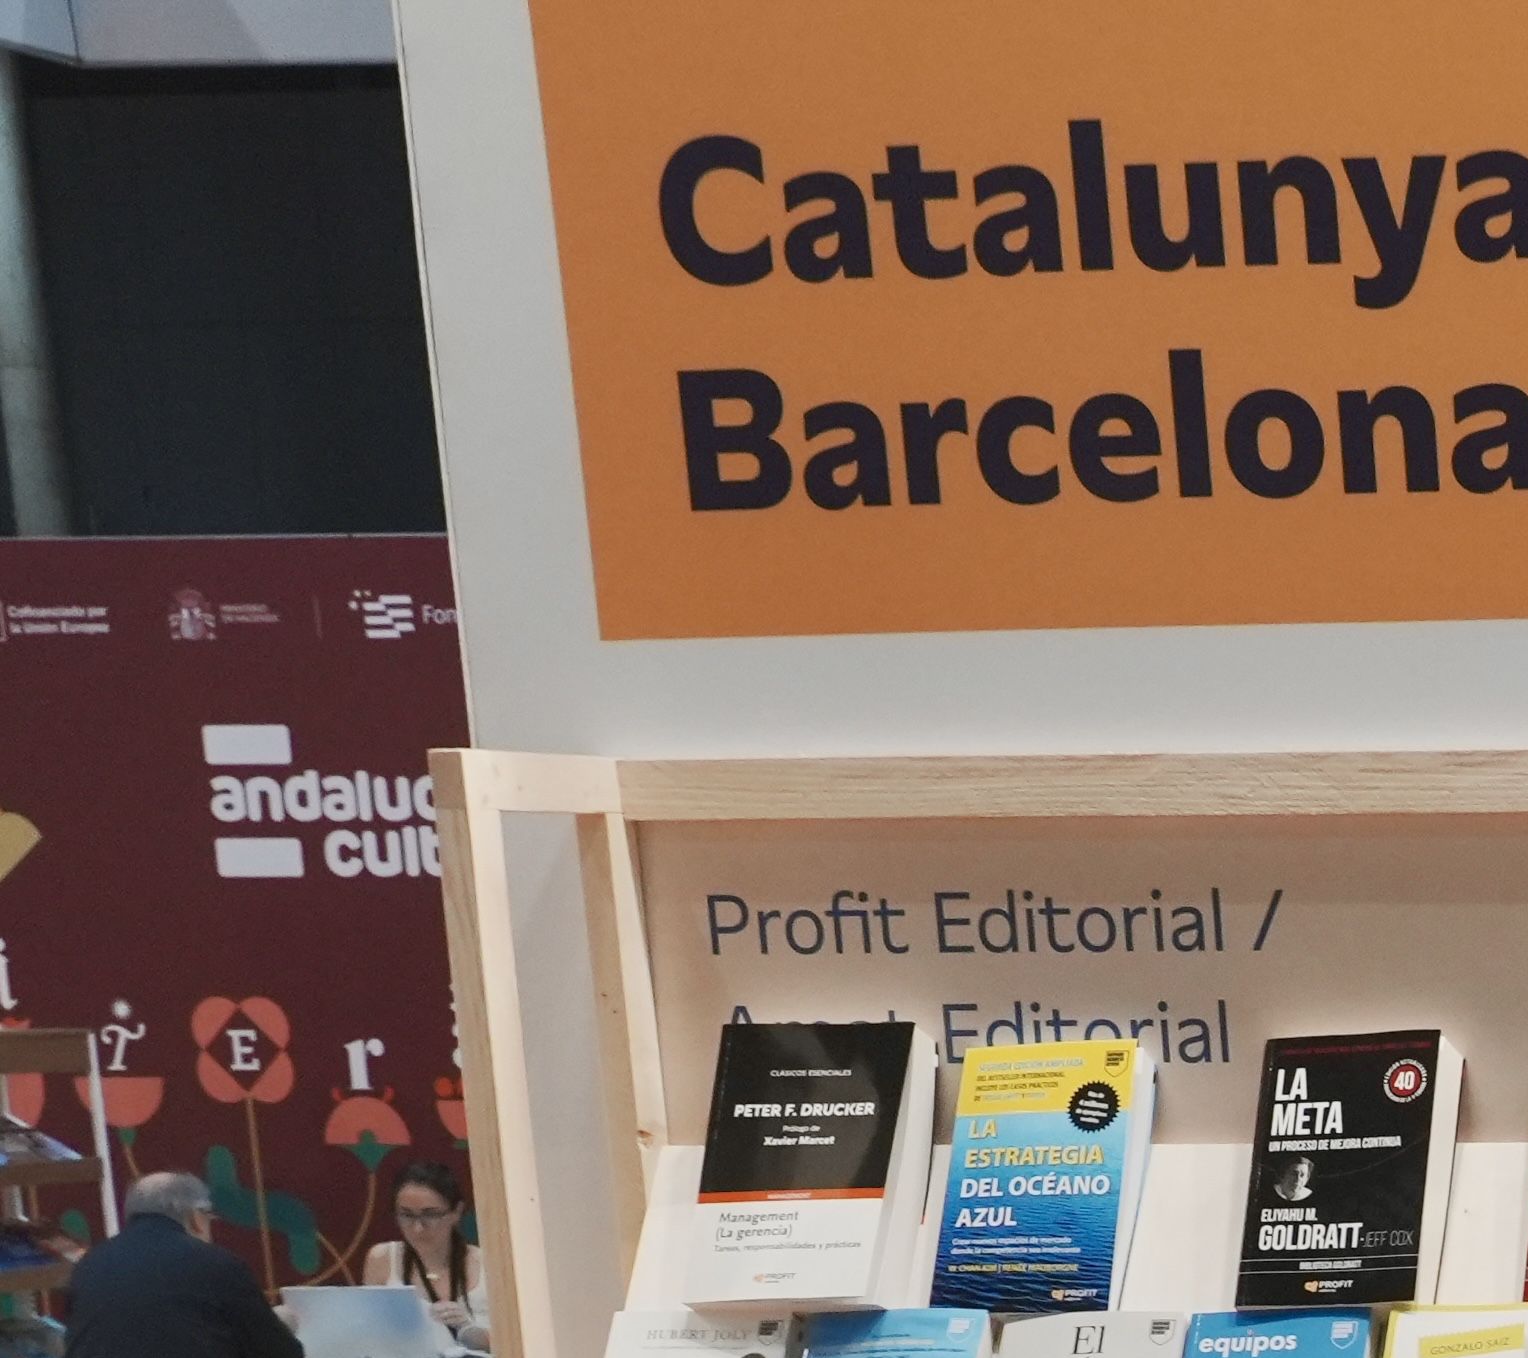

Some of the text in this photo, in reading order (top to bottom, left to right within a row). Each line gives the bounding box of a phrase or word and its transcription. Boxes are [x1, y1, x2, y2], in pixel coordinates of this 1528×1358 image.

[706, 891, 910, 955] Profit
[934, 889, 1224, 954] Editorial
[1275, 1068, 1308, 1101] LA
[1393, 1073, 1415, 1090] 40
[733, 1102, 875, 1118] PETER F. DRUCKER
[1270, 1101, 1343, 1136] META
[968, 1120, 997, 1140] LA
[965, 1146, 1103, 1168] ESTRATEGIA
[960, 1170, 1111, 1198] DEL OCÉANO
[718, 1210, 799, 1224] Management
[955, 1206, 1017, 1228] AZUL
[1260, 1208, 1303, 1222] ELIYAHU
[716, 1224, 792, 1241] (La gerencia)
[1258, 1222, 1363, 1251] GOLDRATT
[1319, 1279, 1353, 1291] PROFIT
[1072, 1325, 1104, 1356] El
[1198, 1329, 1297, 1357] equipos
